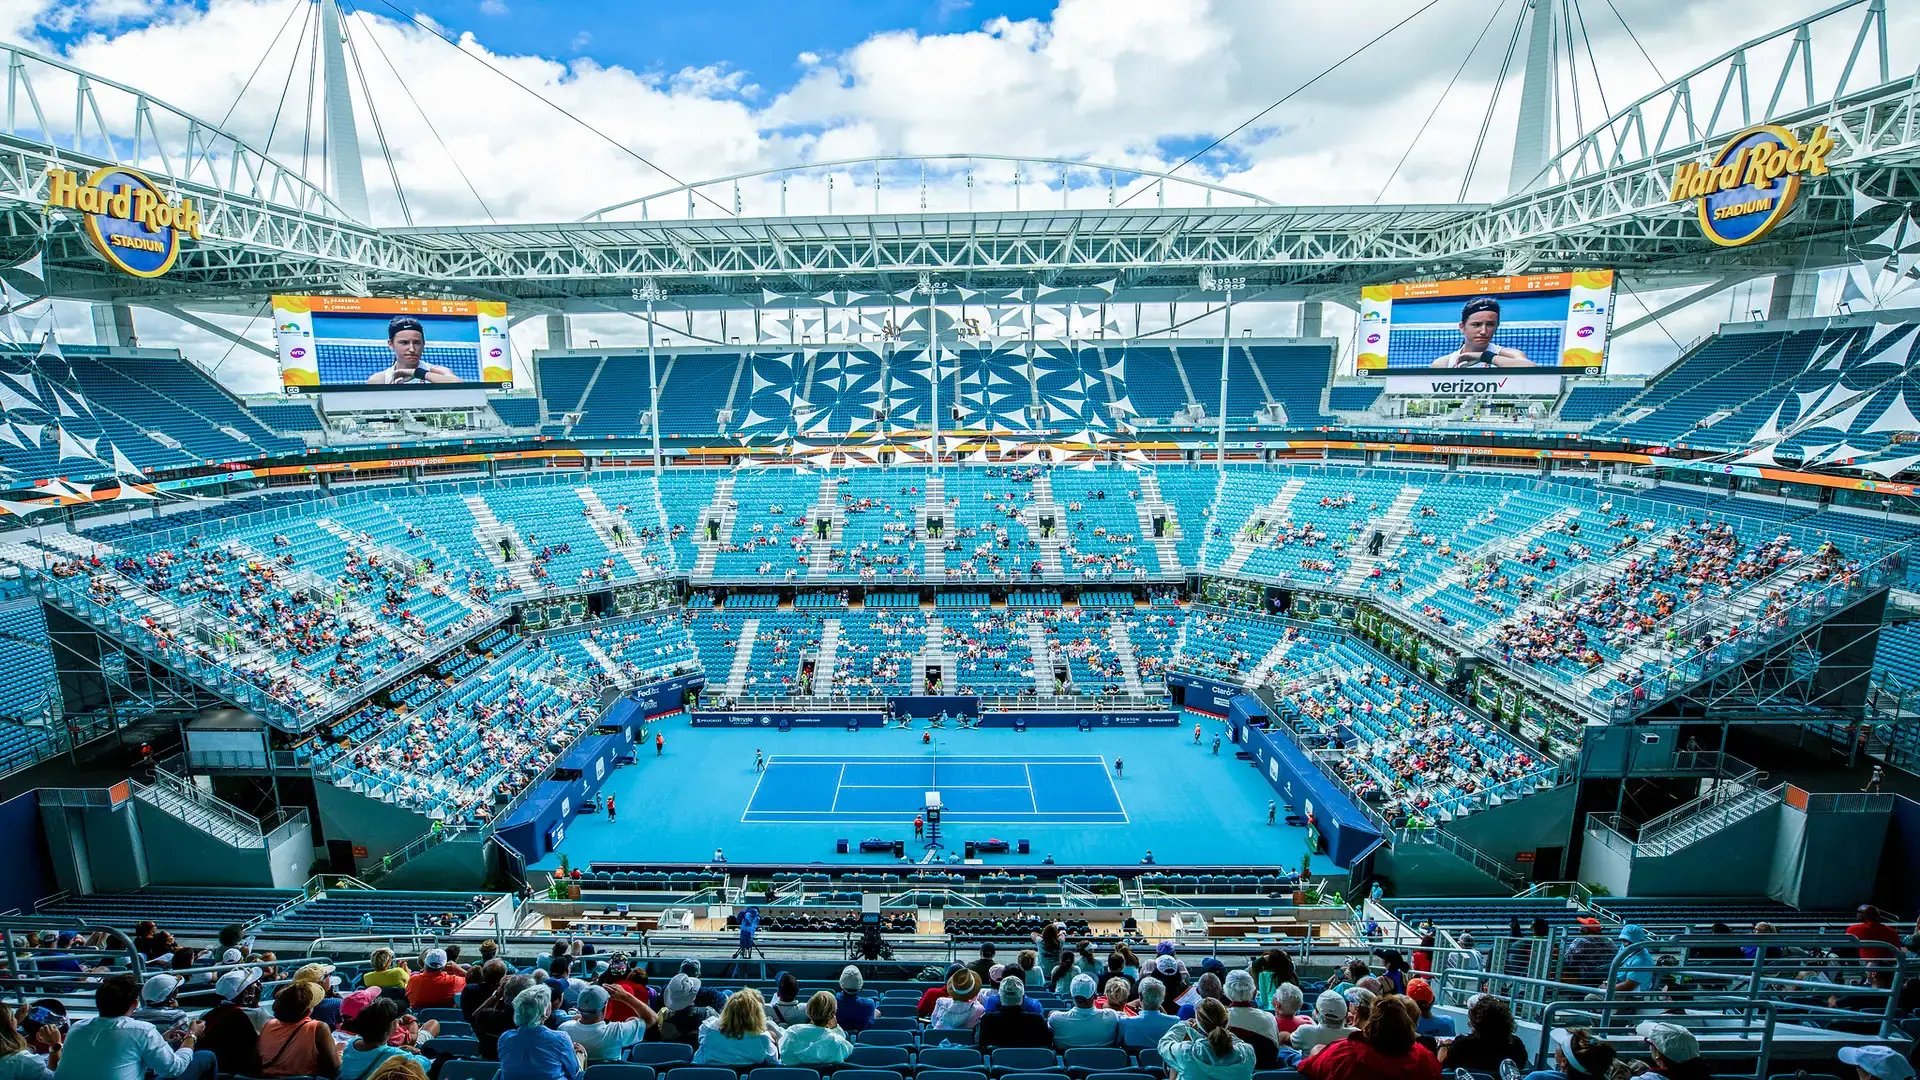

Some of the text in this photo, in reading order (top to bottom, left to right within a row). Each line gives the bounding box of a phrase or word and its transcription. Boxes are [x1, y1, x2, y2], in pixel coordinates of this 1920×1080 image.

[1669, 125, 1834, 202] Hard Rock
[47, 168, 202, 240] Hard Rock
[1713, 198, 1773, 221] STADIUM
[110, 234, 165, 253] STADIUM
[1431, 378, 1498, 393] verizon
[1450, 446, 1473, 454] miami
[390, 457, 446, 467] 2019 miami open
[84, 473, 99, 481] ZACH
[1211, 686, 1232, 696] Claro
